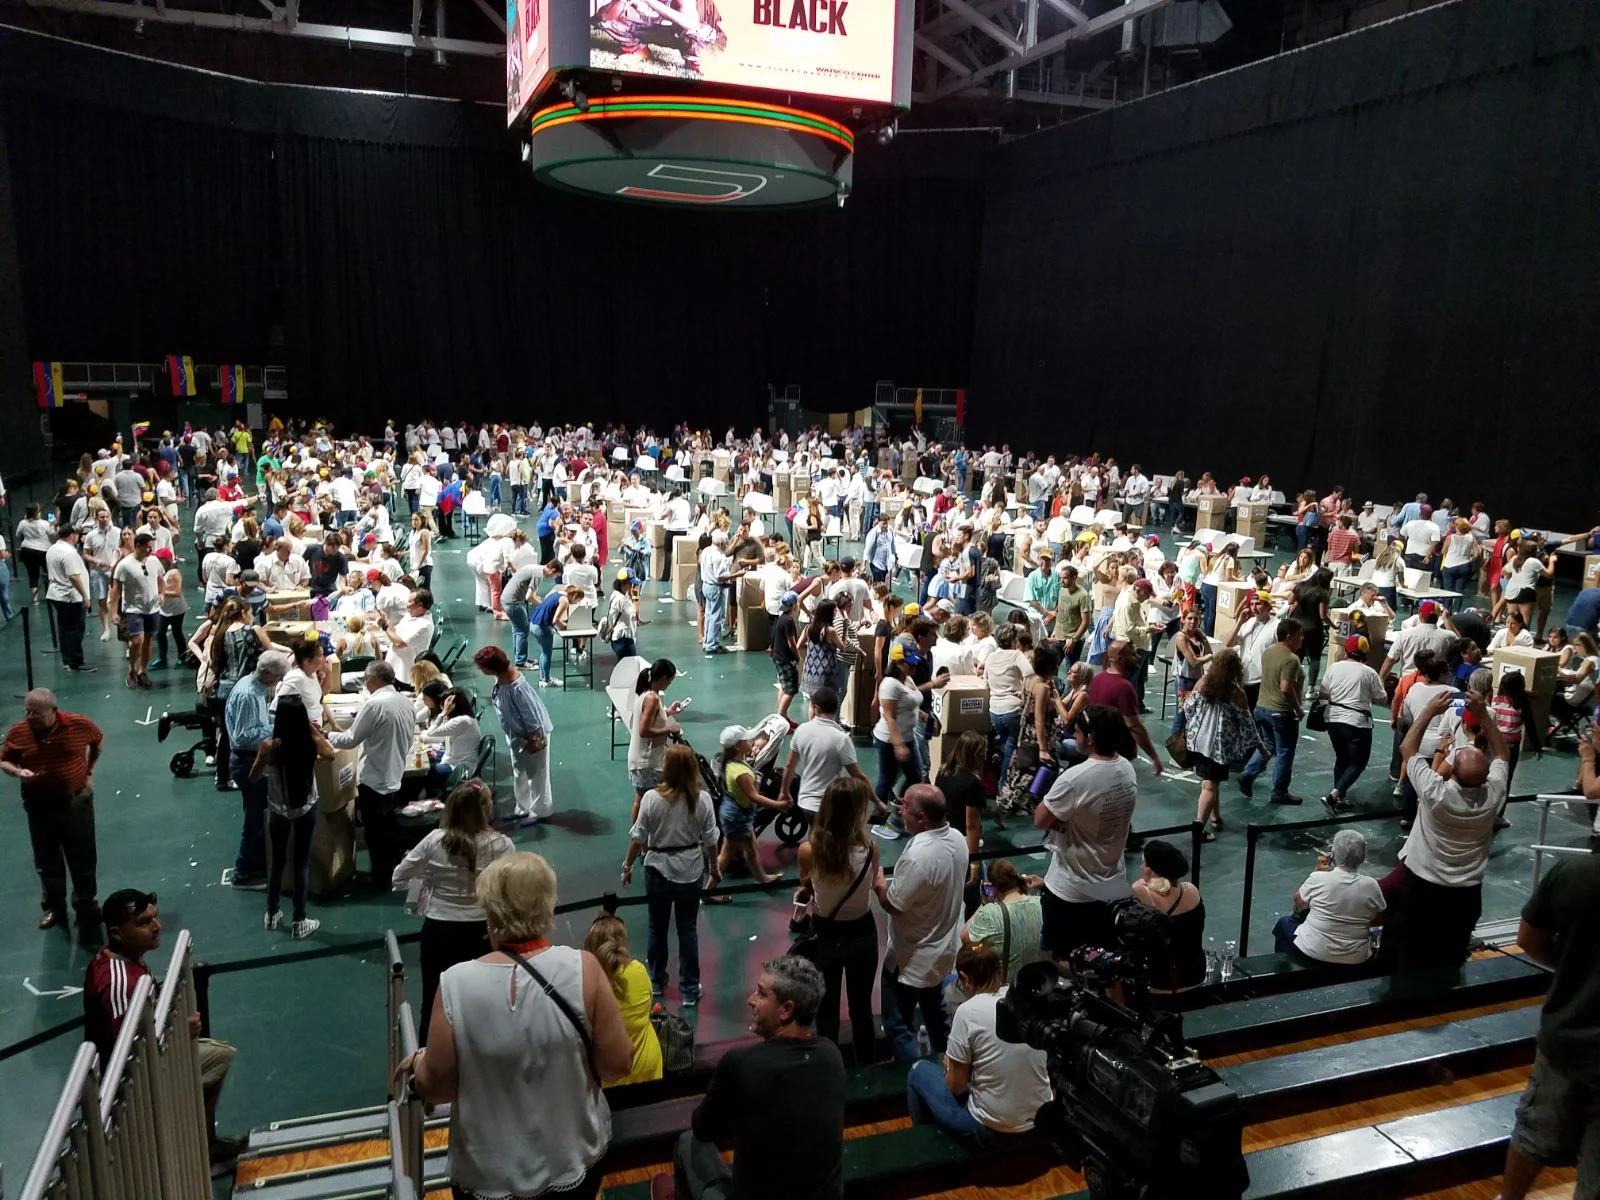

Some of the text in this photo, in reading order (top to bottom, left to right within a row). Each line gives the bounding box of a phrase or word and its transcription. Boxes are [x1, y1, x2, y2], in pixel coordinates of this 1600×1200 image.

[753, 0, 849, 37] BLACK
[1220, 592, 1230, 606] 52
[1336, 621, 1349, 636] 33
